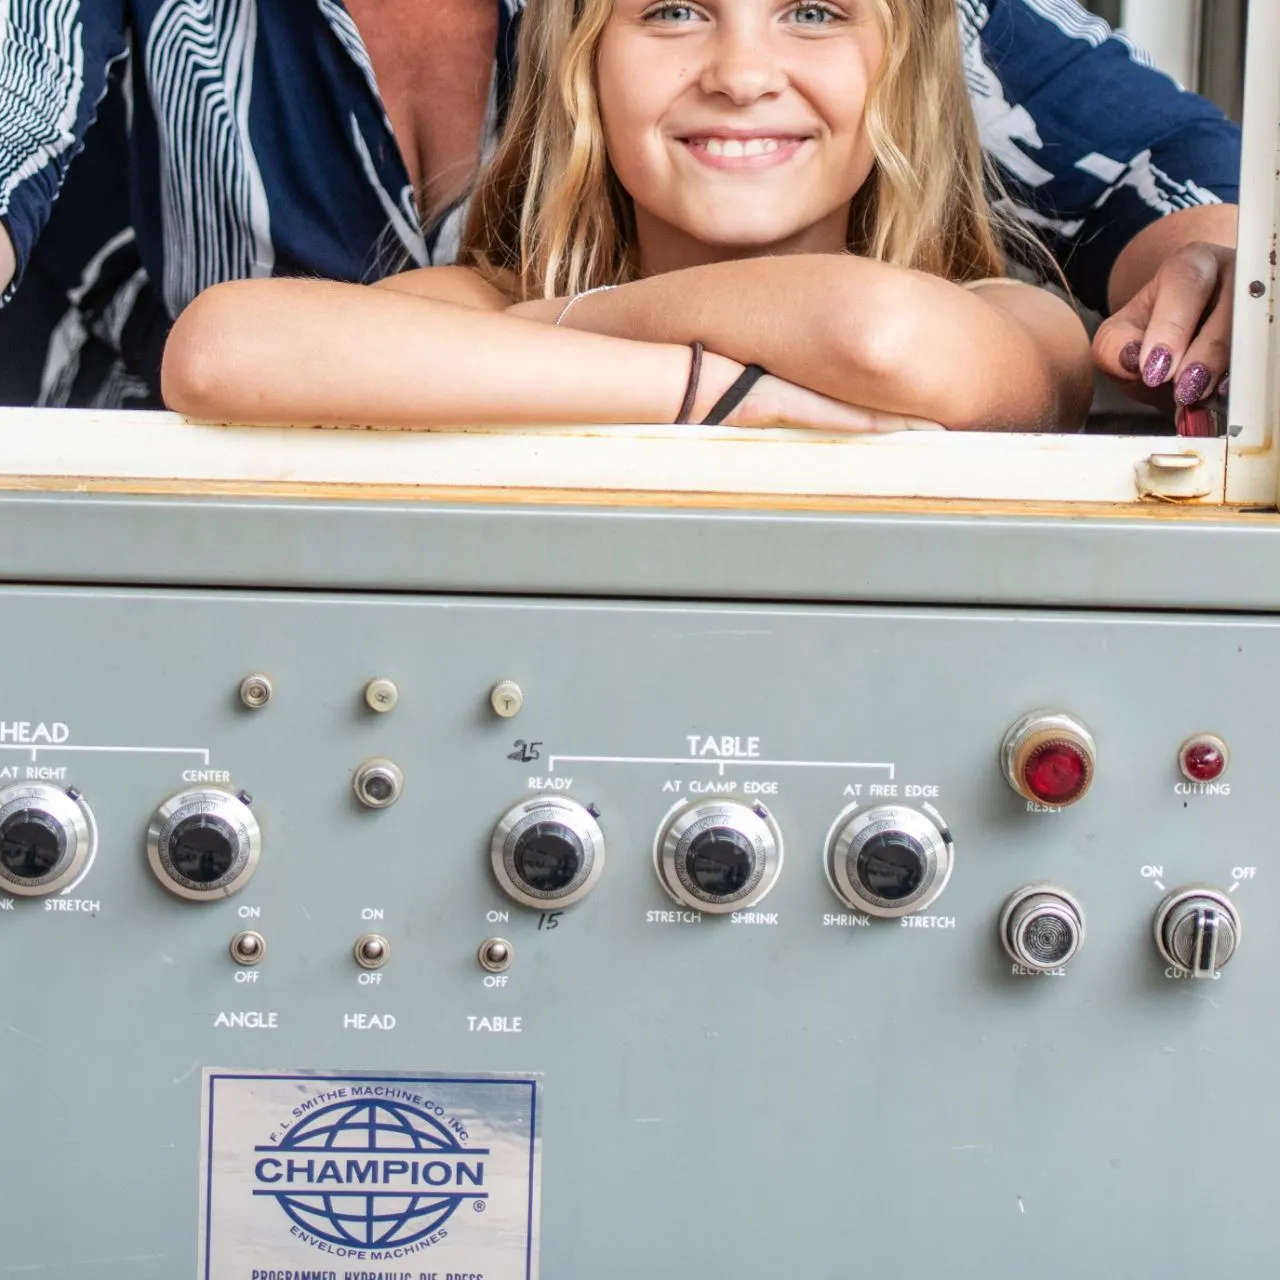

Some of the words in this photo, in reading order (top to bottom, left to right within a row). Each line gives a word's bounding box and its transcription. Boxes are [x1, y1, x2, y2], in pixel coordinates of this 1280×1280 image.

[0, 721, 70, 744] HEAD
[686, 735, 760, 758] TABLE
[0, 766, 20, 779] AT
[26, 767, 67, 780] RIGHT
[182, 769, 230, 783] CENTER
[528, 777, 573, 790] READY
[662, 780, 682, 793] AT
[689, 780, 737, 794] CLAMP
[743, 781, 779, 794] EDGE
[843, 783, 863, 796] AT
[870, 784, 898, 797] FREE
[905, 784, 940, 798] EDGE
[1174, 782, 1231, 796] CUTTING
[1140, 865, 1164, 878] ON
[1231, 866, 1257, 880] OFF
[44, 899, 100, 912] STRETCH
[237, 905, 261, 918] ON
[361, 907, 384, 920] ON
[486, 910, 509, 923] ON
[646, 910, 702, 923] STRETCH
[731, 912, 779, 925] SHRINK
[823, 913, 871, 926] SHRINK
[900, 915, 956, 929] STRETCH
[234, 970, 260, 984] OFF
[357, 972, 383, 986] OFF
[1164, 966, 1222, 980] CUTG
[483, 975, 509, 988] OFF
[214, 1011, 278, 1029] ANGLE
[343, 1013, 396, 1031] HEAD
[466, 1015, 522, 1033] TABLE
[292, 1087, 348, 1118] SMITHE
[351, 1086, 423, 1105] MACHINE
[424, 1100, 446, 1120] CO.
[254, 1157, 485, 1186] CHAMPION
[289, 1224, 367, 1260] ENVELOPE
[370, 1227, 449, 1261] MACHINES
